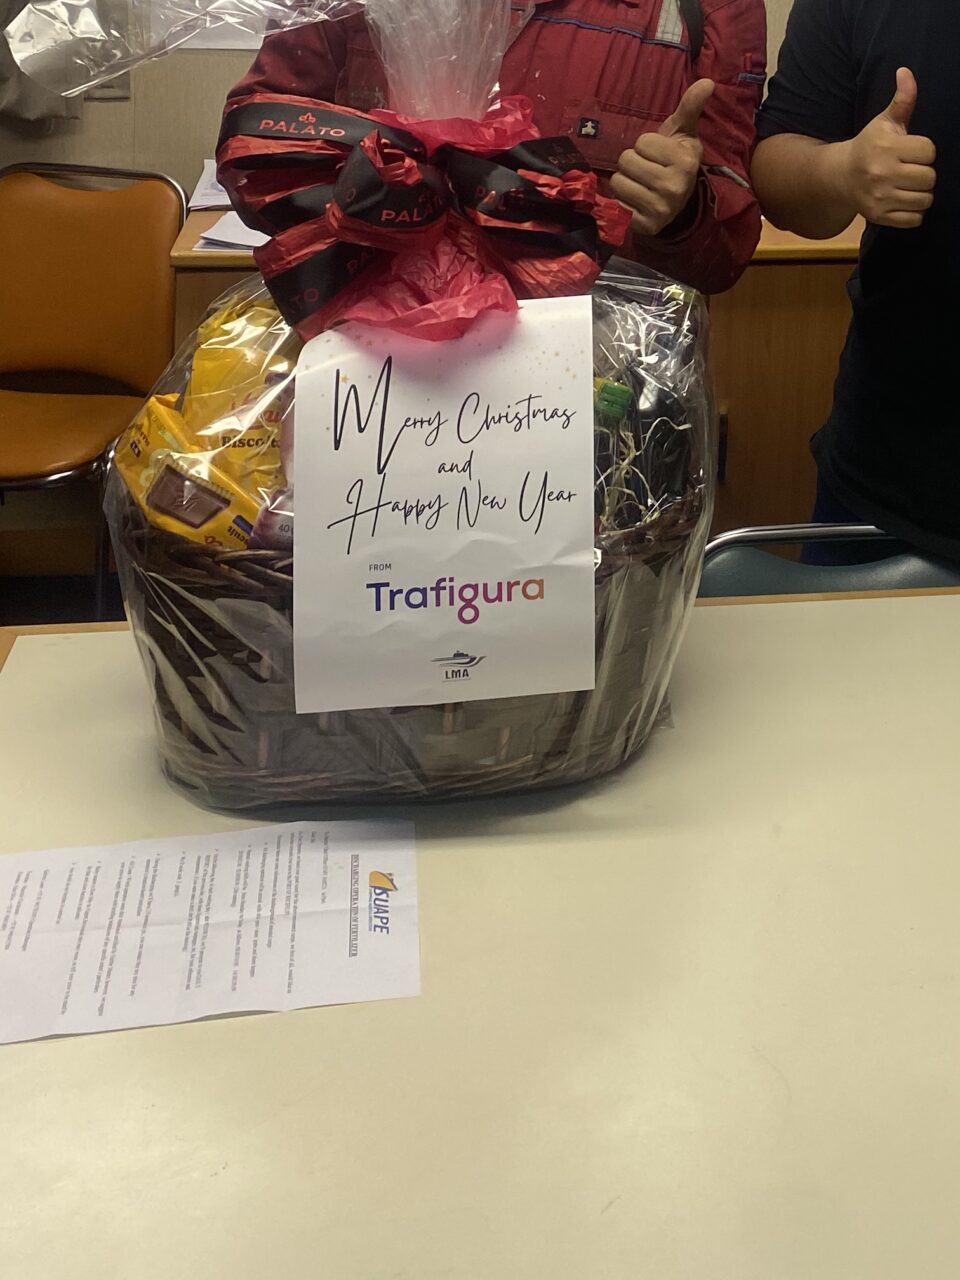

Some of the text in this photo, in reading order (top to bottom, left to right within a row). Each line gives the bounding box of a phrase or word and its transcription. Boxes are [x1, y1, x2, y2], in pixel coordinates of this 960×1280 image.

[259, 118, 346, 137] PALATO
[333, 355, 576, 475] Merry Christmas
[438, 449, 474, 480] and
[327, 470, 576, 555] Happy New Year
[368, 563, 392, 572] FROM
[366, 576, 544, 624] Trafigura
[445, 669, 470, 680] LMA
